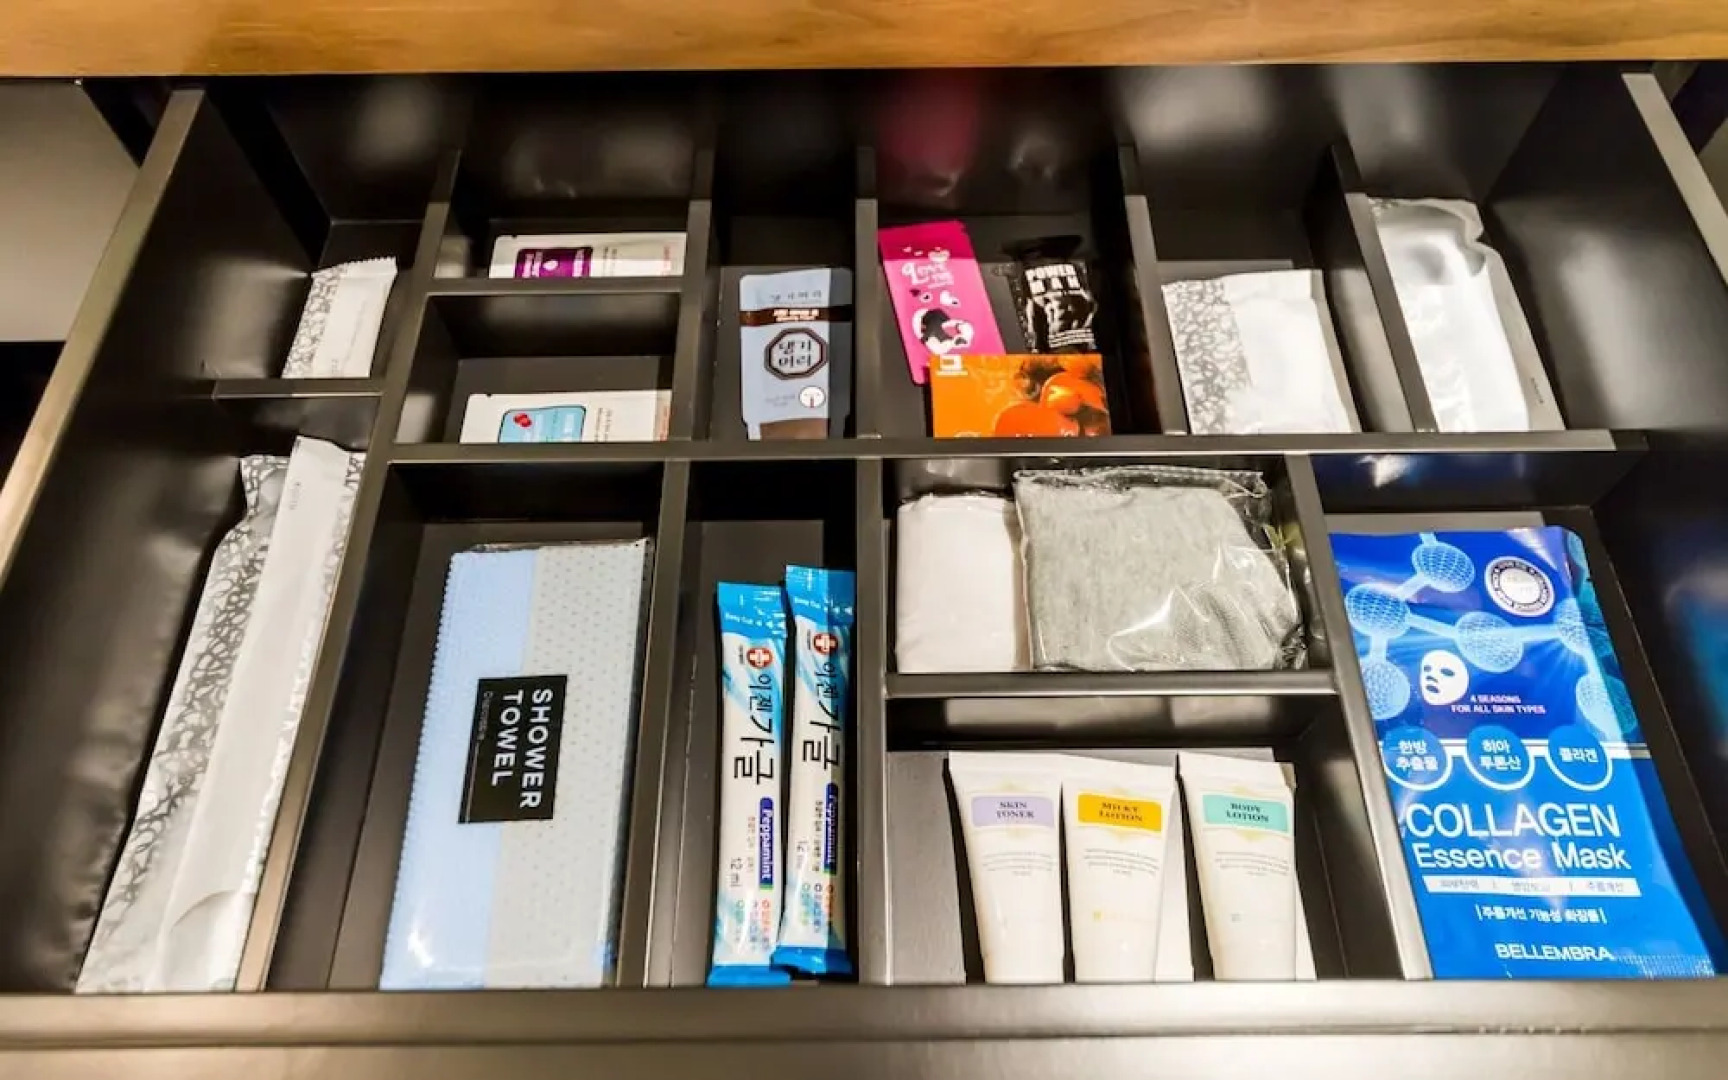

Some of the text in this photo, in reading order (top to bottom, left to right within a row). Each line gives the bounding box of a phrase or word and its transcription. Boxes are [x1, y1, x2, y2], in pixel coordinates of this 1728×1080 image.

[1450, 704, 1546, 714] FOR ALL SKIN TYPES
[491, 689, 524, 787] TOWEL
[520, 688, 554, 808] SHOWER
[997, 810, 1034, 819] TONER
[1231, 803, 1260, 812] BODY
[1099, 810, 1143, 822] LOTION
[1226, 810, 1269, 822] LOTION
[1405, 803, 1621, 838] COLLAGEN
[1412, 841, 1631, 870] Essence Mask
[1494, 943, 1616, 961] BELLEMBRA
